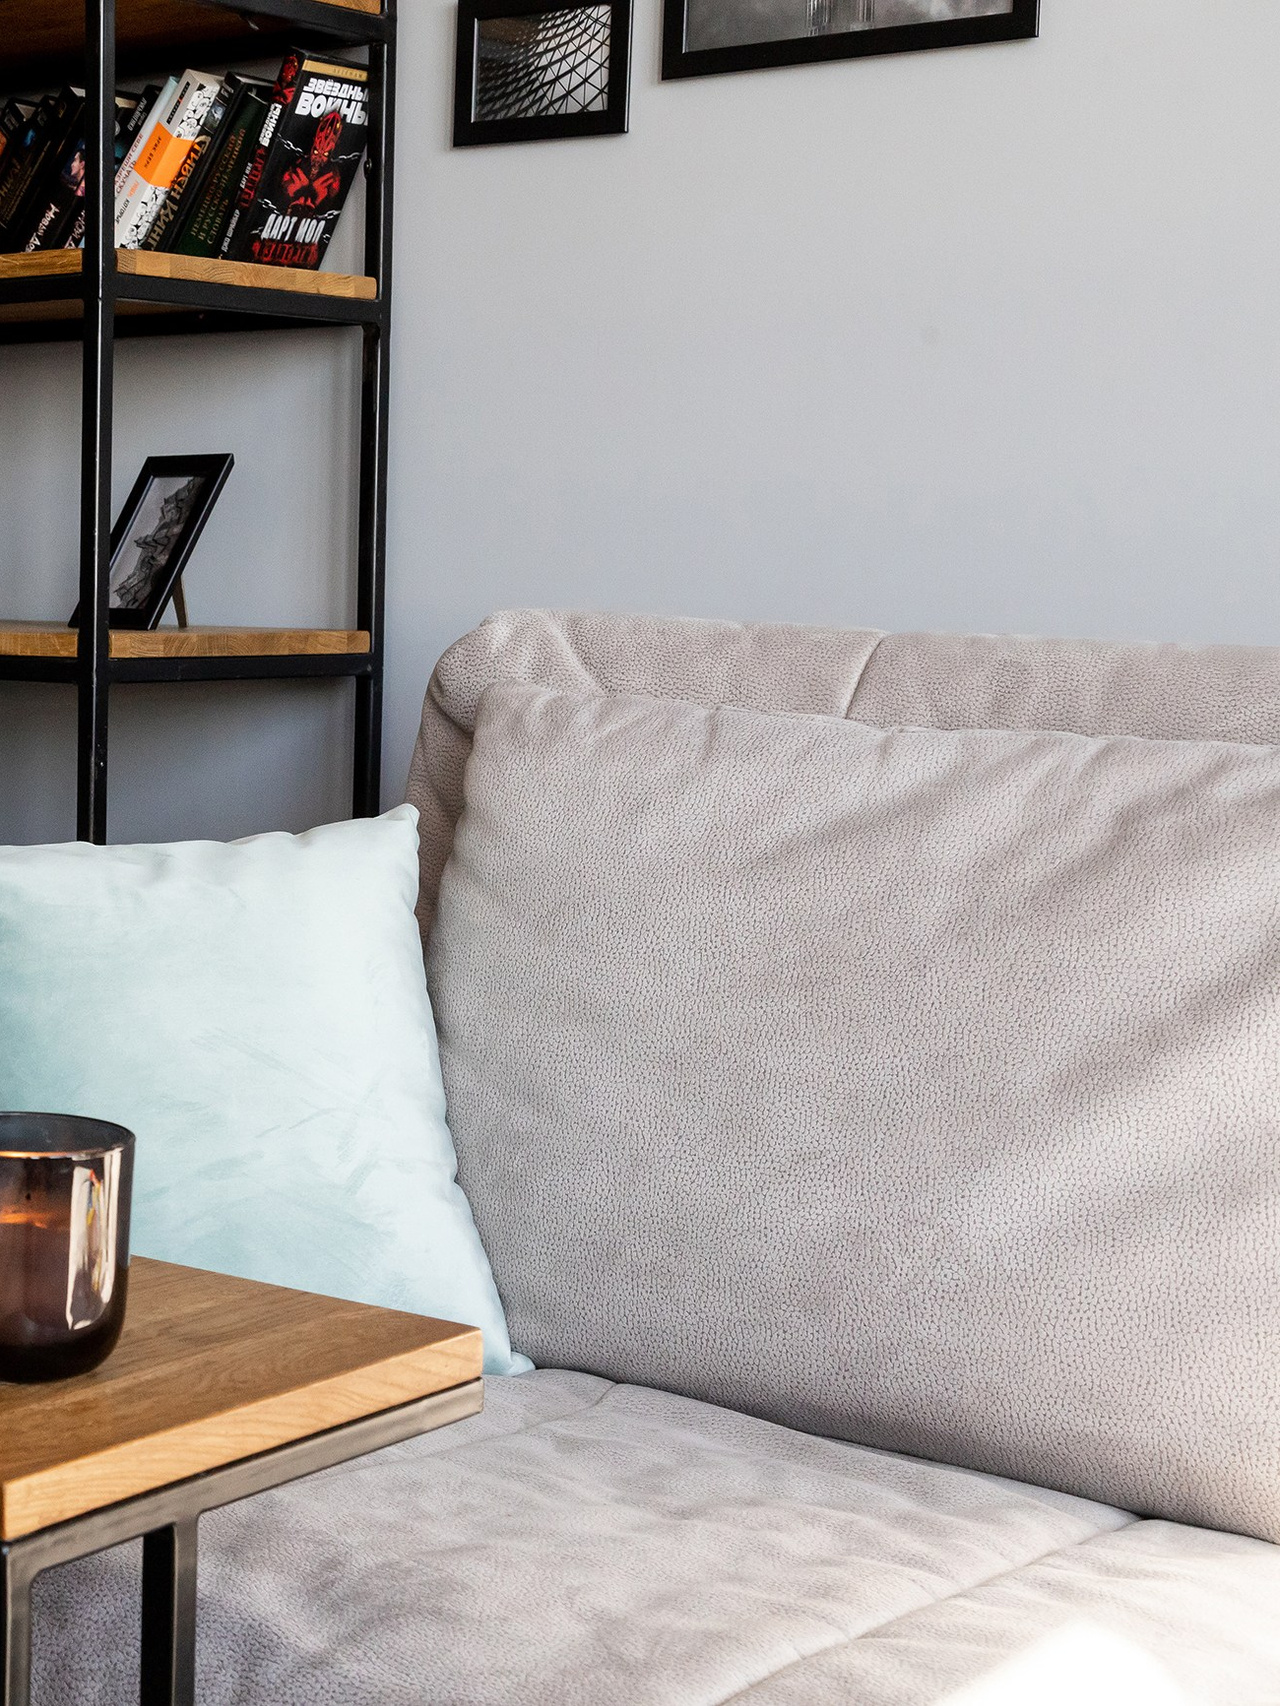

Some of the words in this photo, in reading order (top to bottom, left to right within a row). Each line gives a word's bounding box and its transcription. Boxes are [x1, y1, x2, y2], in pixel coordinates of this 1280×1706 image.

[302, 77, 368, 102] ЗВЁЗДНЫ
[260, 102, 283, 146] ВОЙНЫ
[114, 152, 133, 185] АЗРЕШИ
[130, 132, 143, 152] СЕБЕ
[115, 159, 137, 194] СКУЧАТЬ
[206, 197, 230, 244] СЛОВАРЬ
[261, 213, 297, 242] ДАРТ
